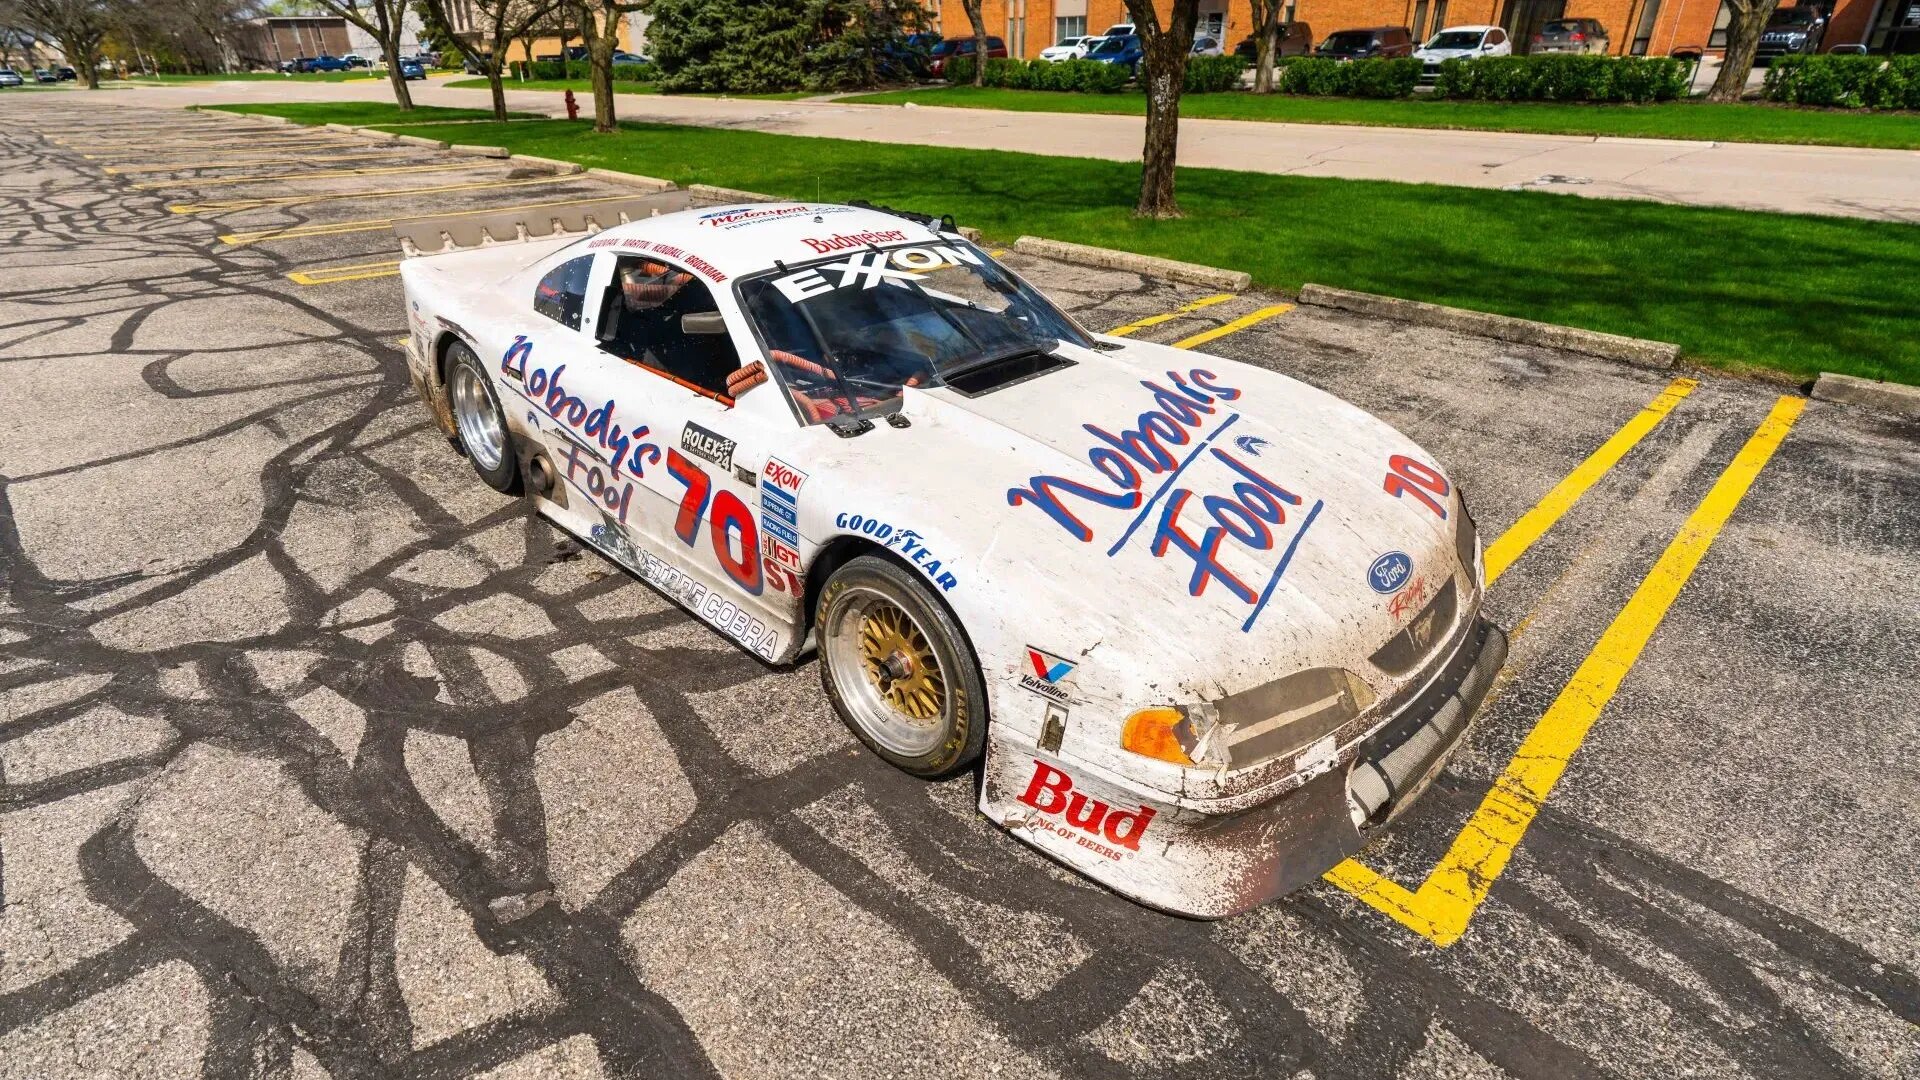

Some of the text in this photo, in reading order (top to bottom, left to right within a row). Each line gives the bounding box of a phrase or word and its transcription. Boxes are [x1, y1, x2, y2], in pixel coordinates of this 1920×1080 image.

[700, 206, 810, 227] Motorsport
[801, 229, 908, 254] Budweiser
[622, 238, 650, 249] MARTIN
[652, 243, 683, 259] KENDALL
[685, 254, 728, 283] BROCKMAN
[771, 246, 985, 304] EXXON
[682, 427, 721, 457] ROLEX
[716, 451, 732, 472] 24
[764, 460, 802, 491] EXXON
[1383, 454, 1449, 520] 70
[666, 446, 764, 597] 70
[763, 497, 785, 517] SUPREME
[763, 517, 797, 543] RACING FUELS
[1150, 447, 1302, 604] Fool
[776, 543, 799, 568] GT
[1375, 558, 1407, 587] Ford
[702, 592, 778, 659] COBRA
[1021, 674, 1069, 699] Valvoline
[1016, 759, 1157, 852] Bud
[1056, 826, 1076, 841] OF
[1076, 836, 1122, 861] BEERS
